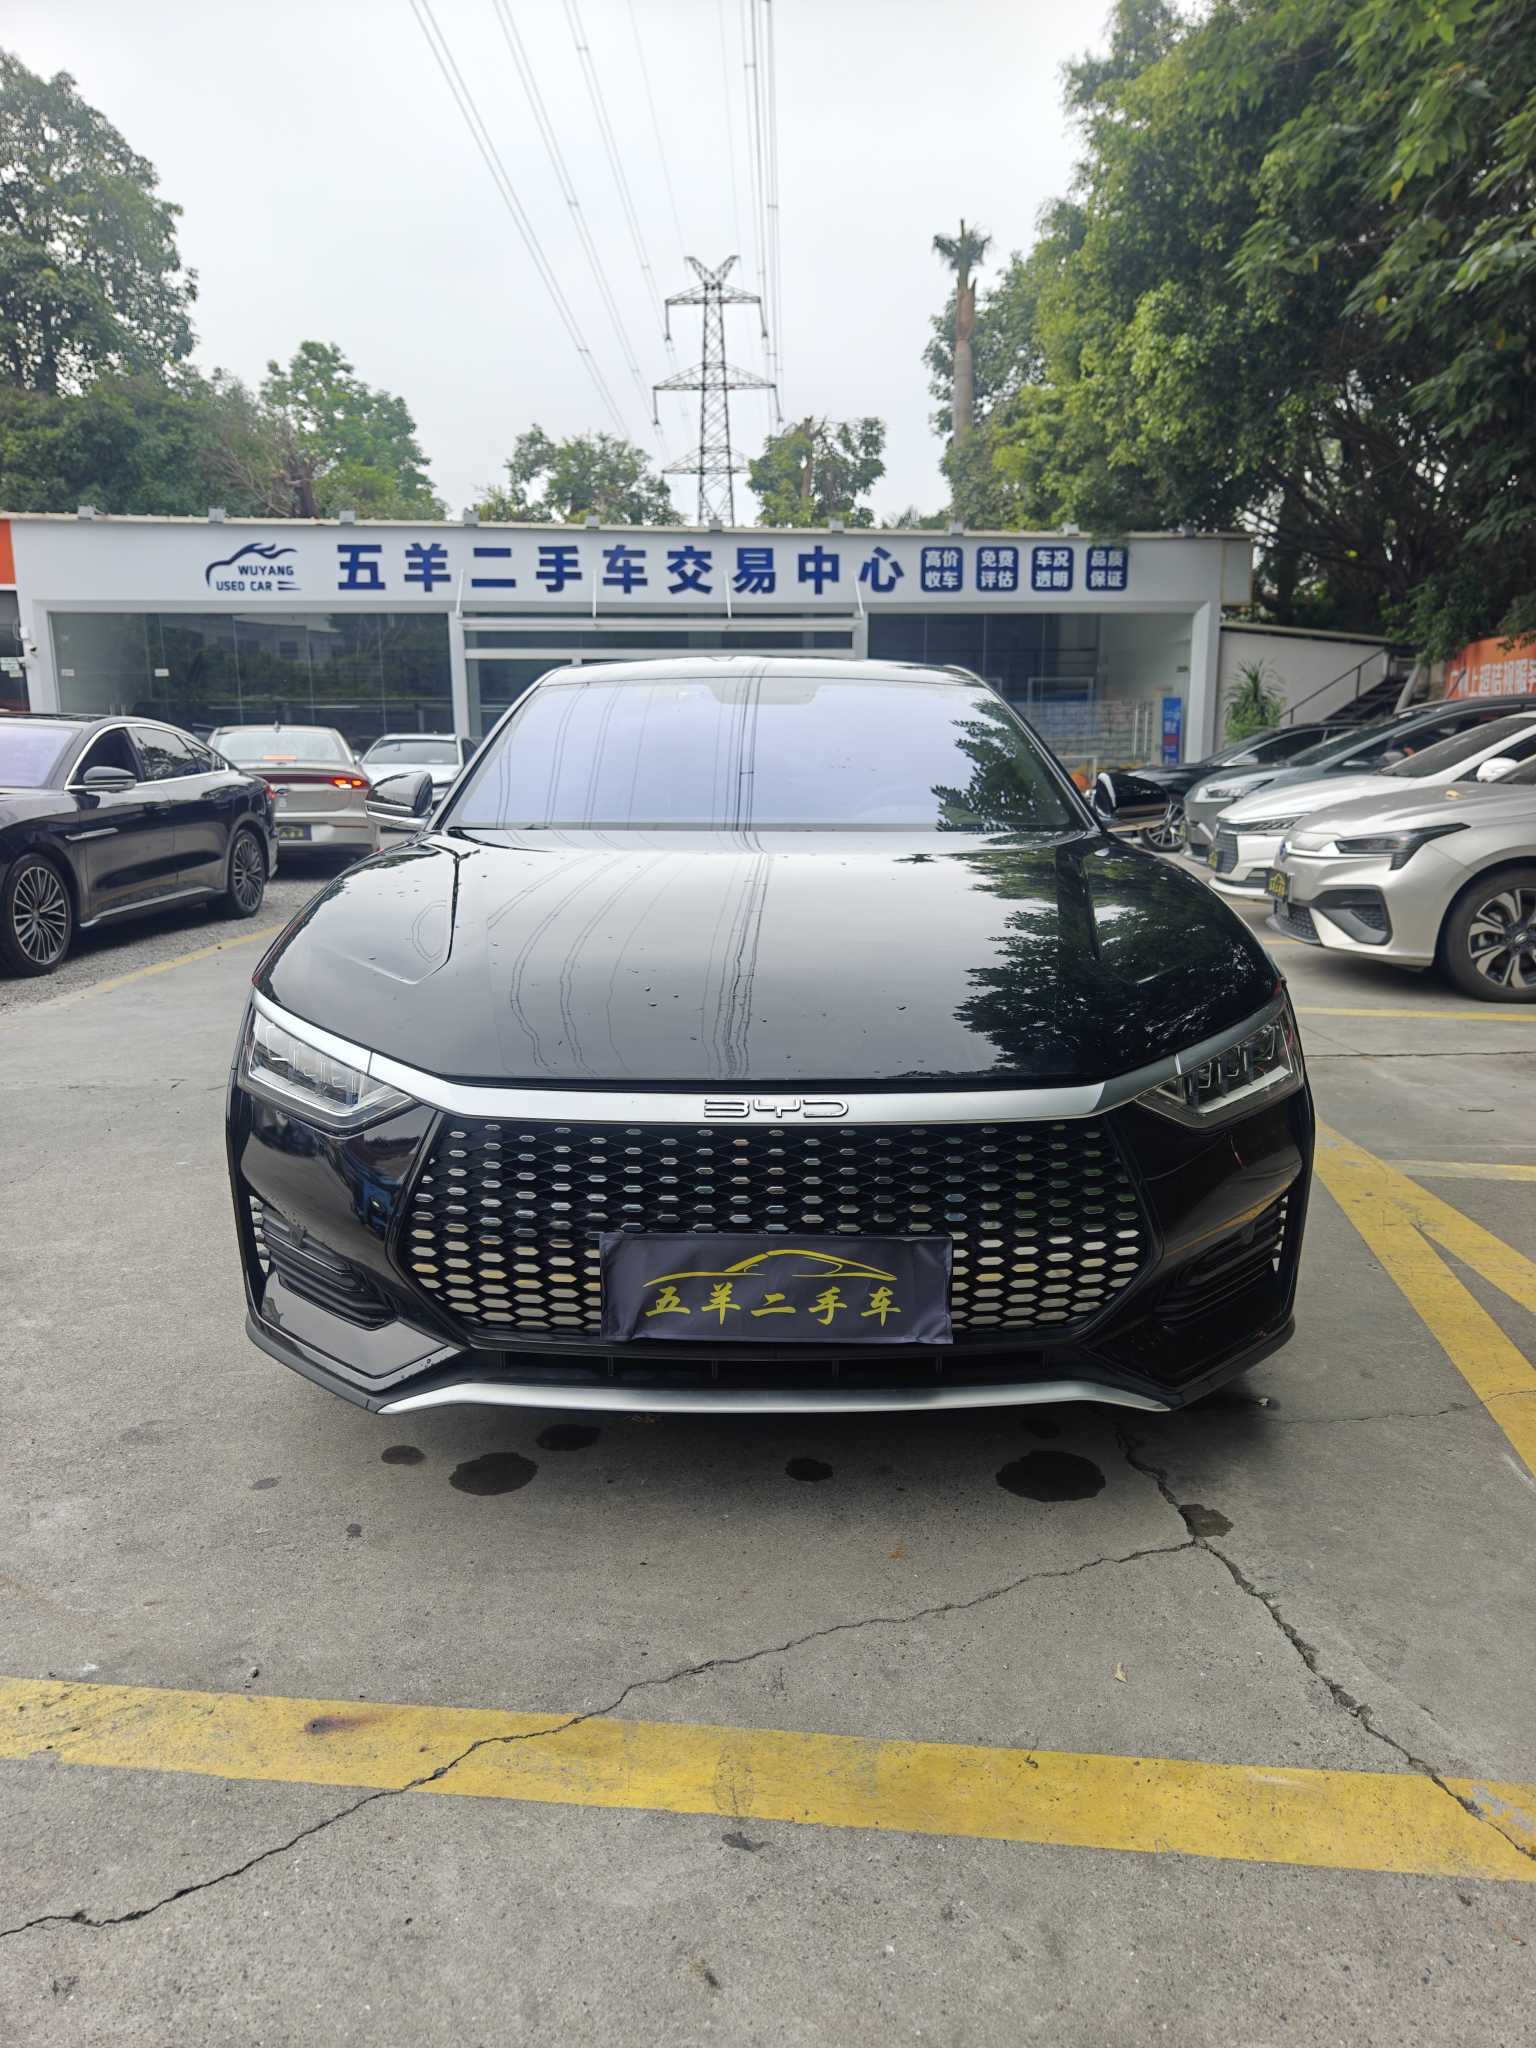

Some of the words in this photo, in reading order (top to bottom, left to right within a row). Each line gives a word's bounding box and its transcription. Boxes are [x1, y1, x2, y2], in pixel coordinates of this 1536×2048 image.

[925, 551, 959, 568] 高价
[981, 551, 1014, 568] 免费
[1036, 551, 1069, 567] 车况
[1091, 550, 1123, 567] 品质
[238, 565, 294, 576] WUYANG
[336, 542, 905, 594] 五羊二手车交易中心
[216, 581, 245, 591] USED
[250, 581, 272, 591] CAR
[925, 571, 959, 588] 收车
[981, 571, 1014, 588] 评估
[1036, 571, 1069, 588] 透明
[1091, 571, 1123, 588] 保证
[704, 1097, 849, 1118] BYD
[645, 1282, 901, 1326] 五羊二手车
